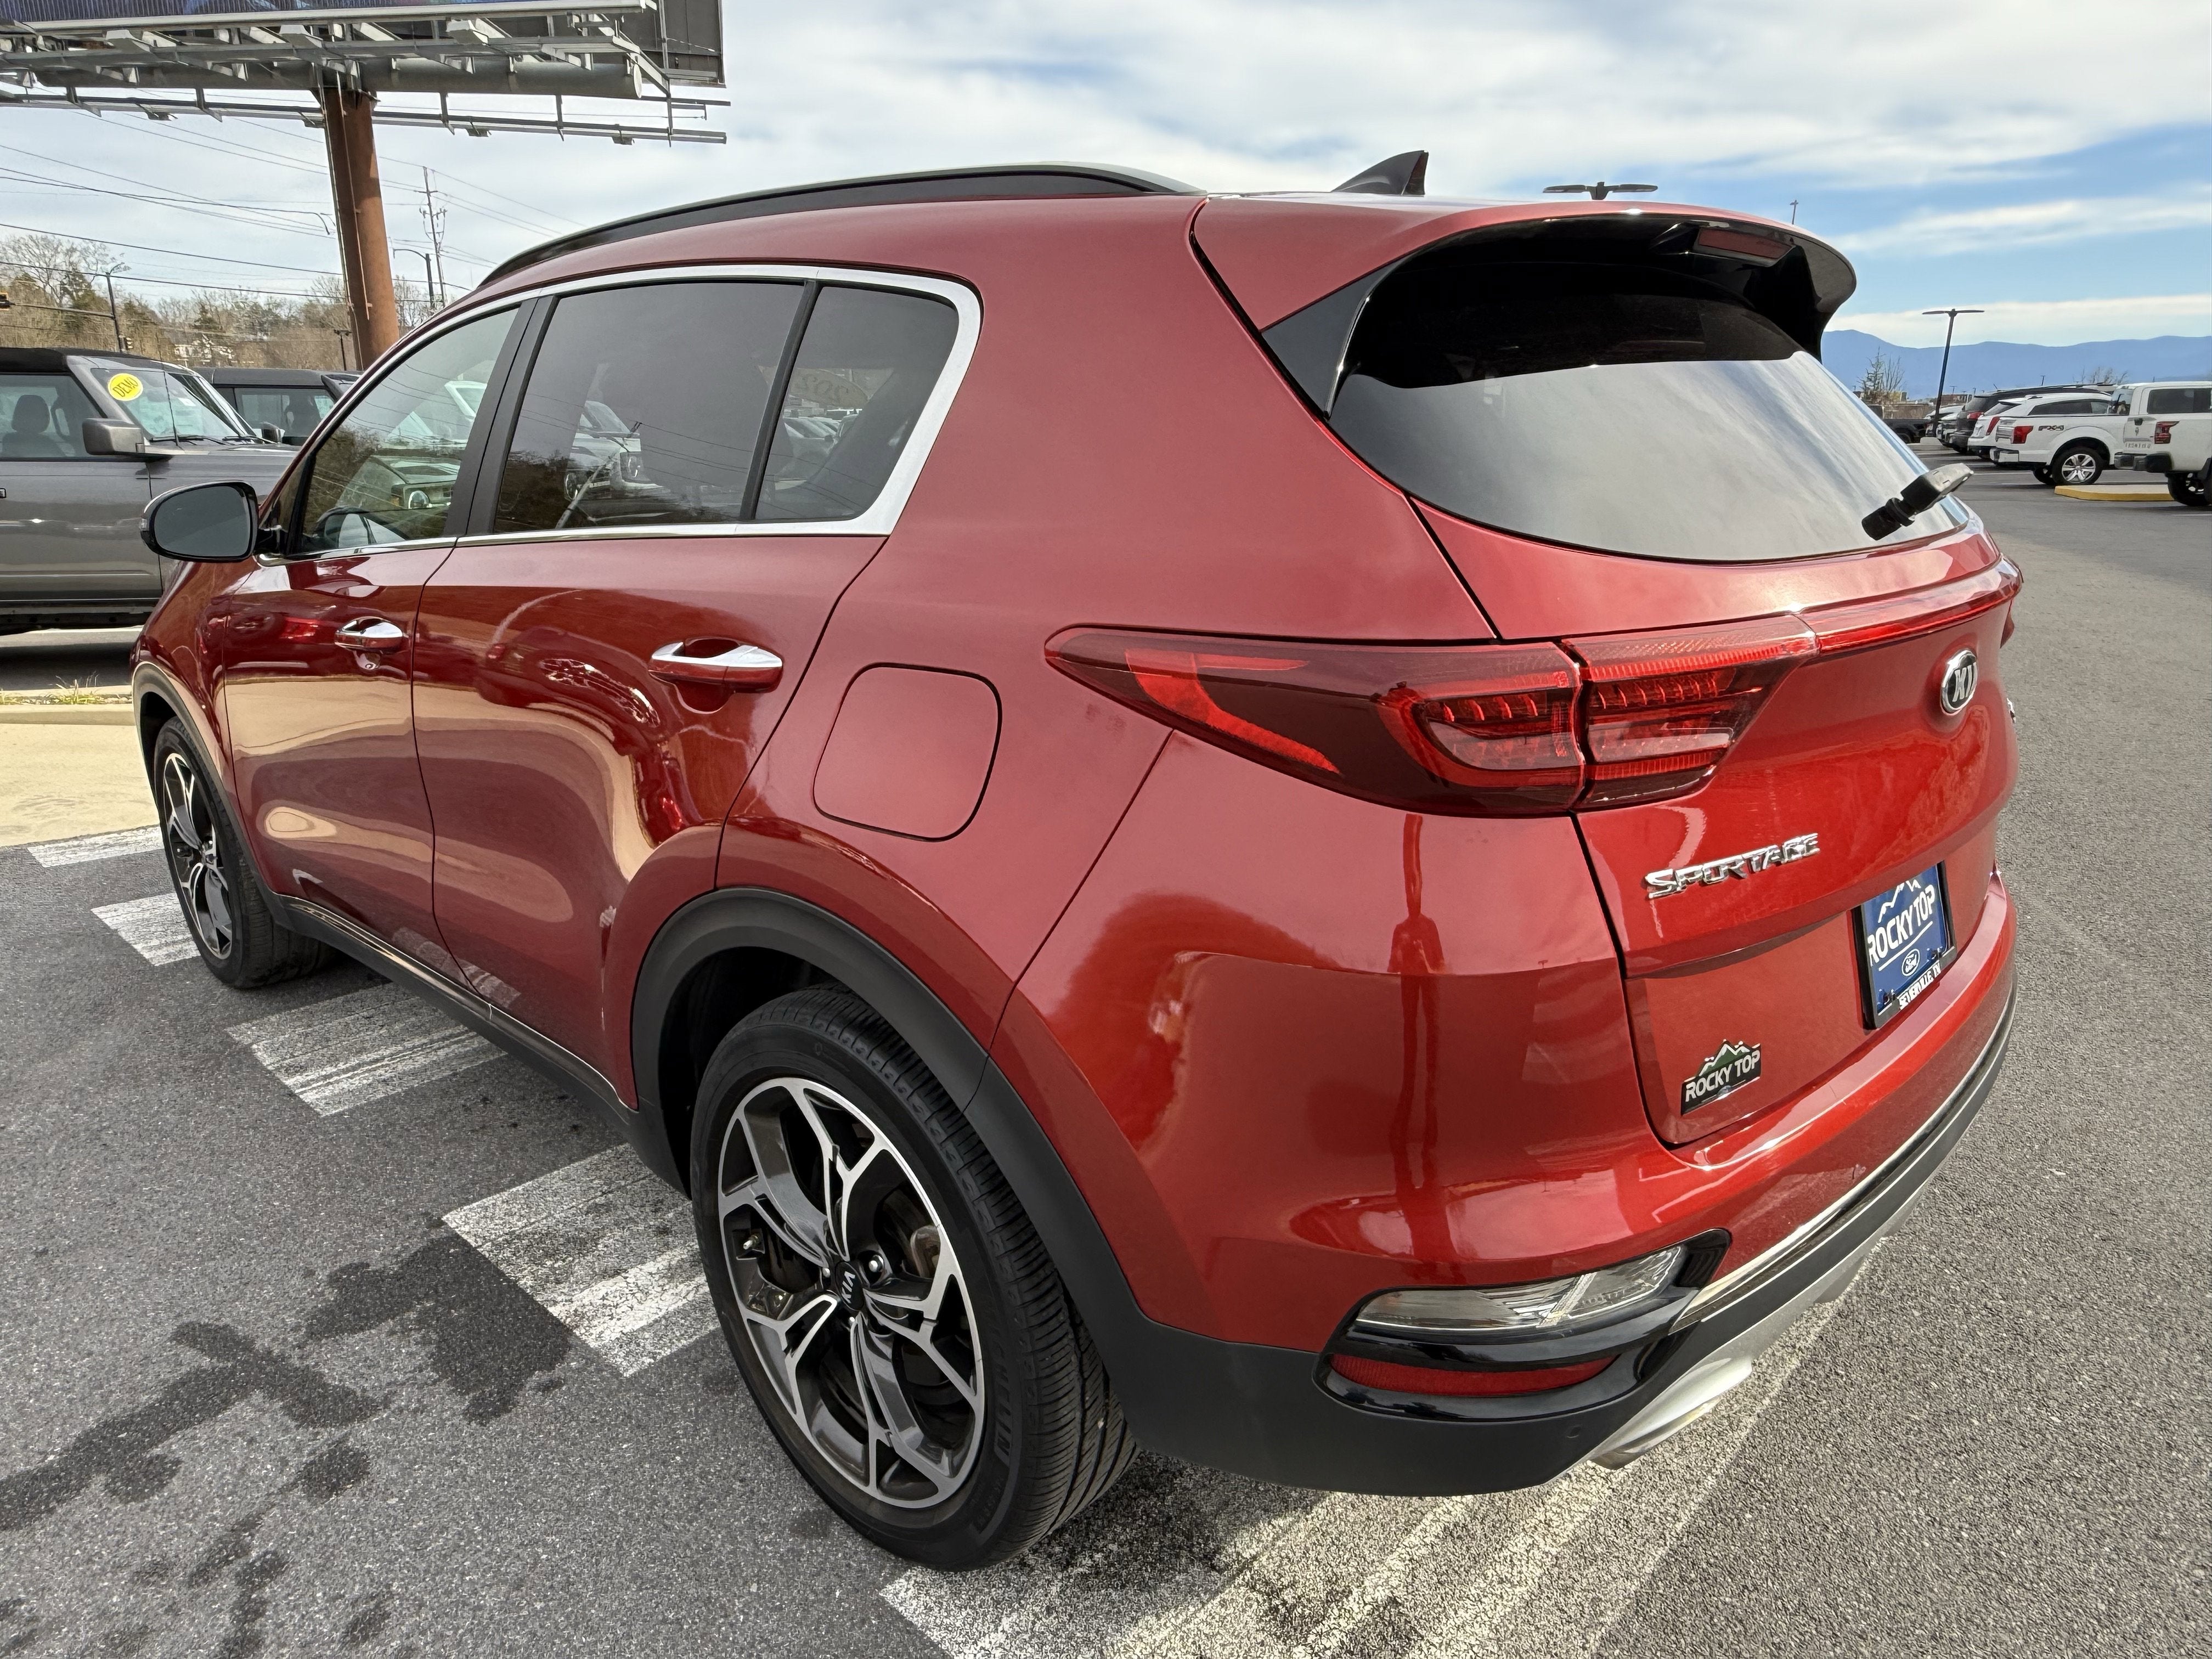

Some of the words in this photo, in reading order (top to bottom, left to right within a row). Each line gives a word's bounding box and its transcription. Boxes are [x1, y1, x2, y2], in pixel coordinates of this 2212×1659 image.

[112, 377, 138, 397] DEMO
[1952, 663, 1976, 702] KI
[1645, 832, 1821, 899] SPORTAGE
[1867, 905, 1914, 967] ROCKY
[1913, 884, 1936, 927] TOP
[1685, 1063, 1733, 1102] ROCKY
[1734, 1049, 1760, 1077] TOP
[842, 1271, 856, 1304] KIA
